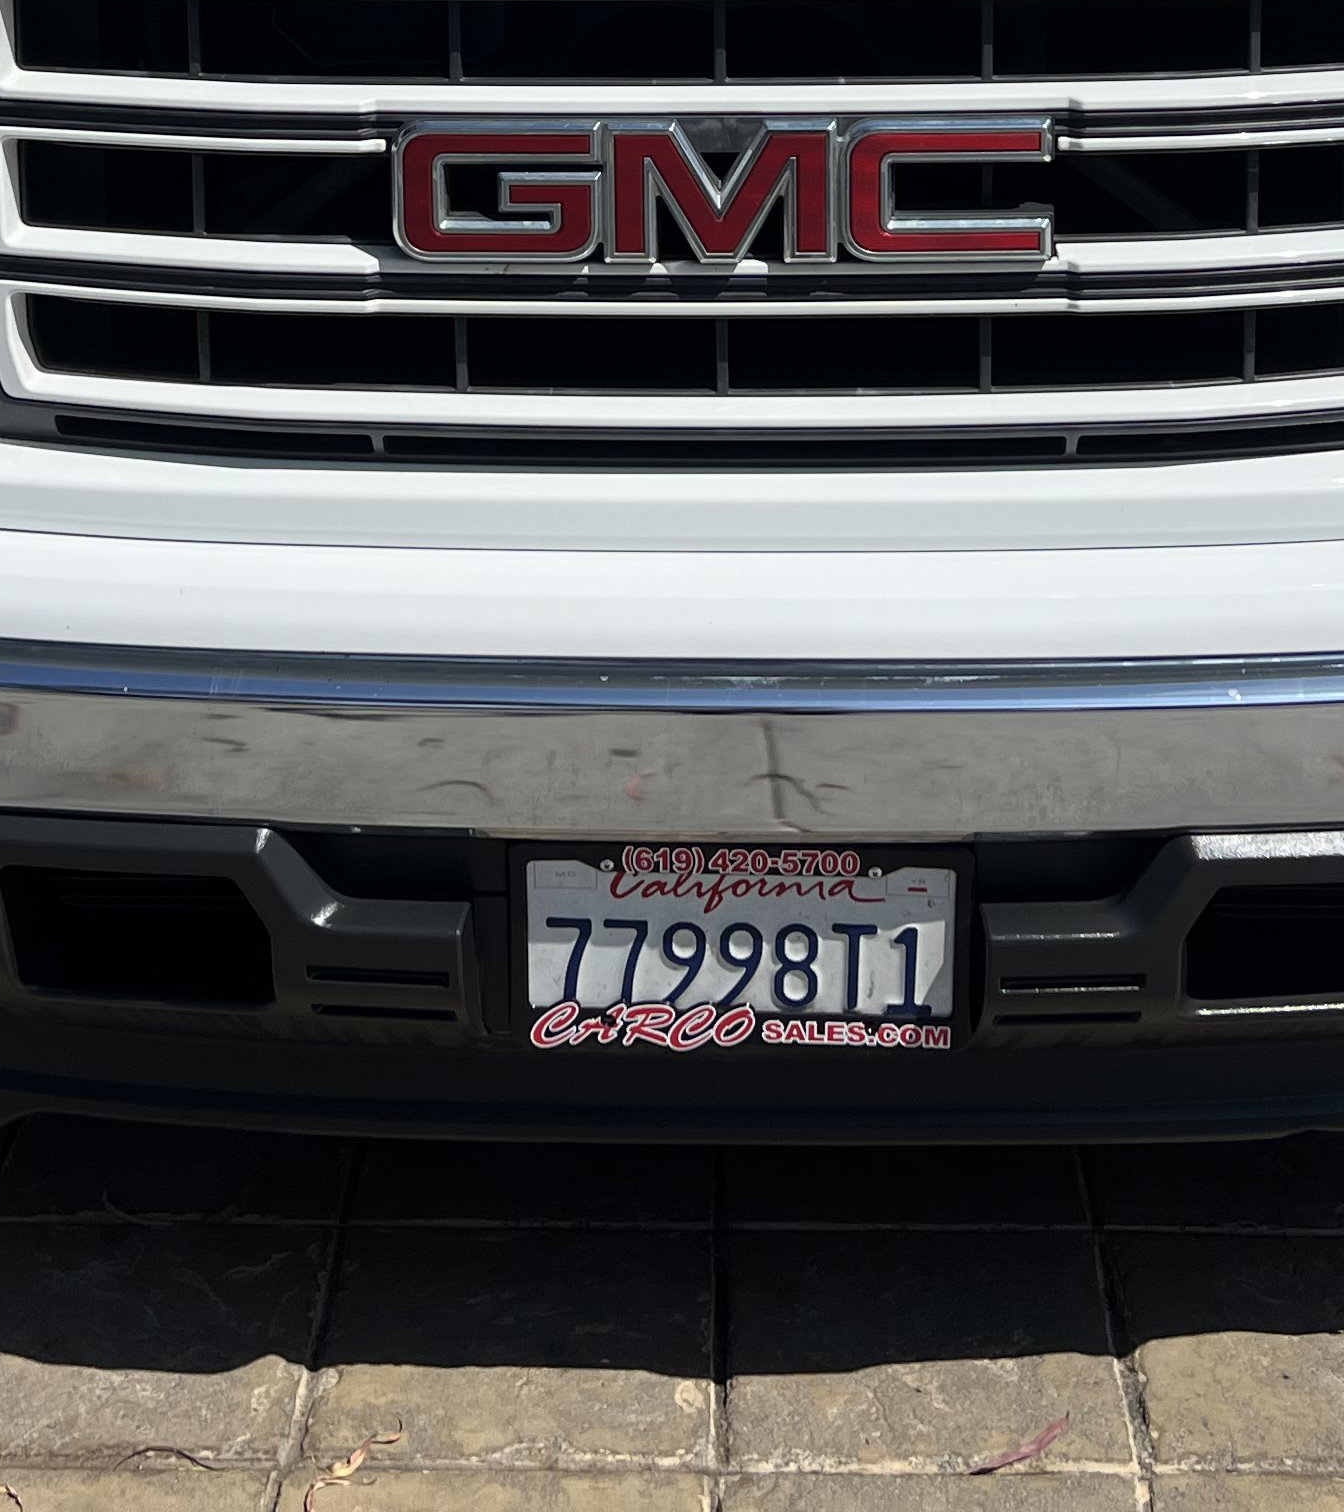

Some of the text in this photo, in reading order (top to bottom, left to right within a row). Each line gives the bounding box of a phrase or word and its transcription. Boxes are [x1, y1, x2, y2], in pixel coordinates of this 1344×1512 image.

[391, 114, 1055, 264] GMC
[621, 845, 861, 877] (619) 420-5700
[609, 870, 886, 915] California
[545, 917, 932, 1016] 77998T1
[529, 1001, 952, 1052] CARCO SALES.COM
